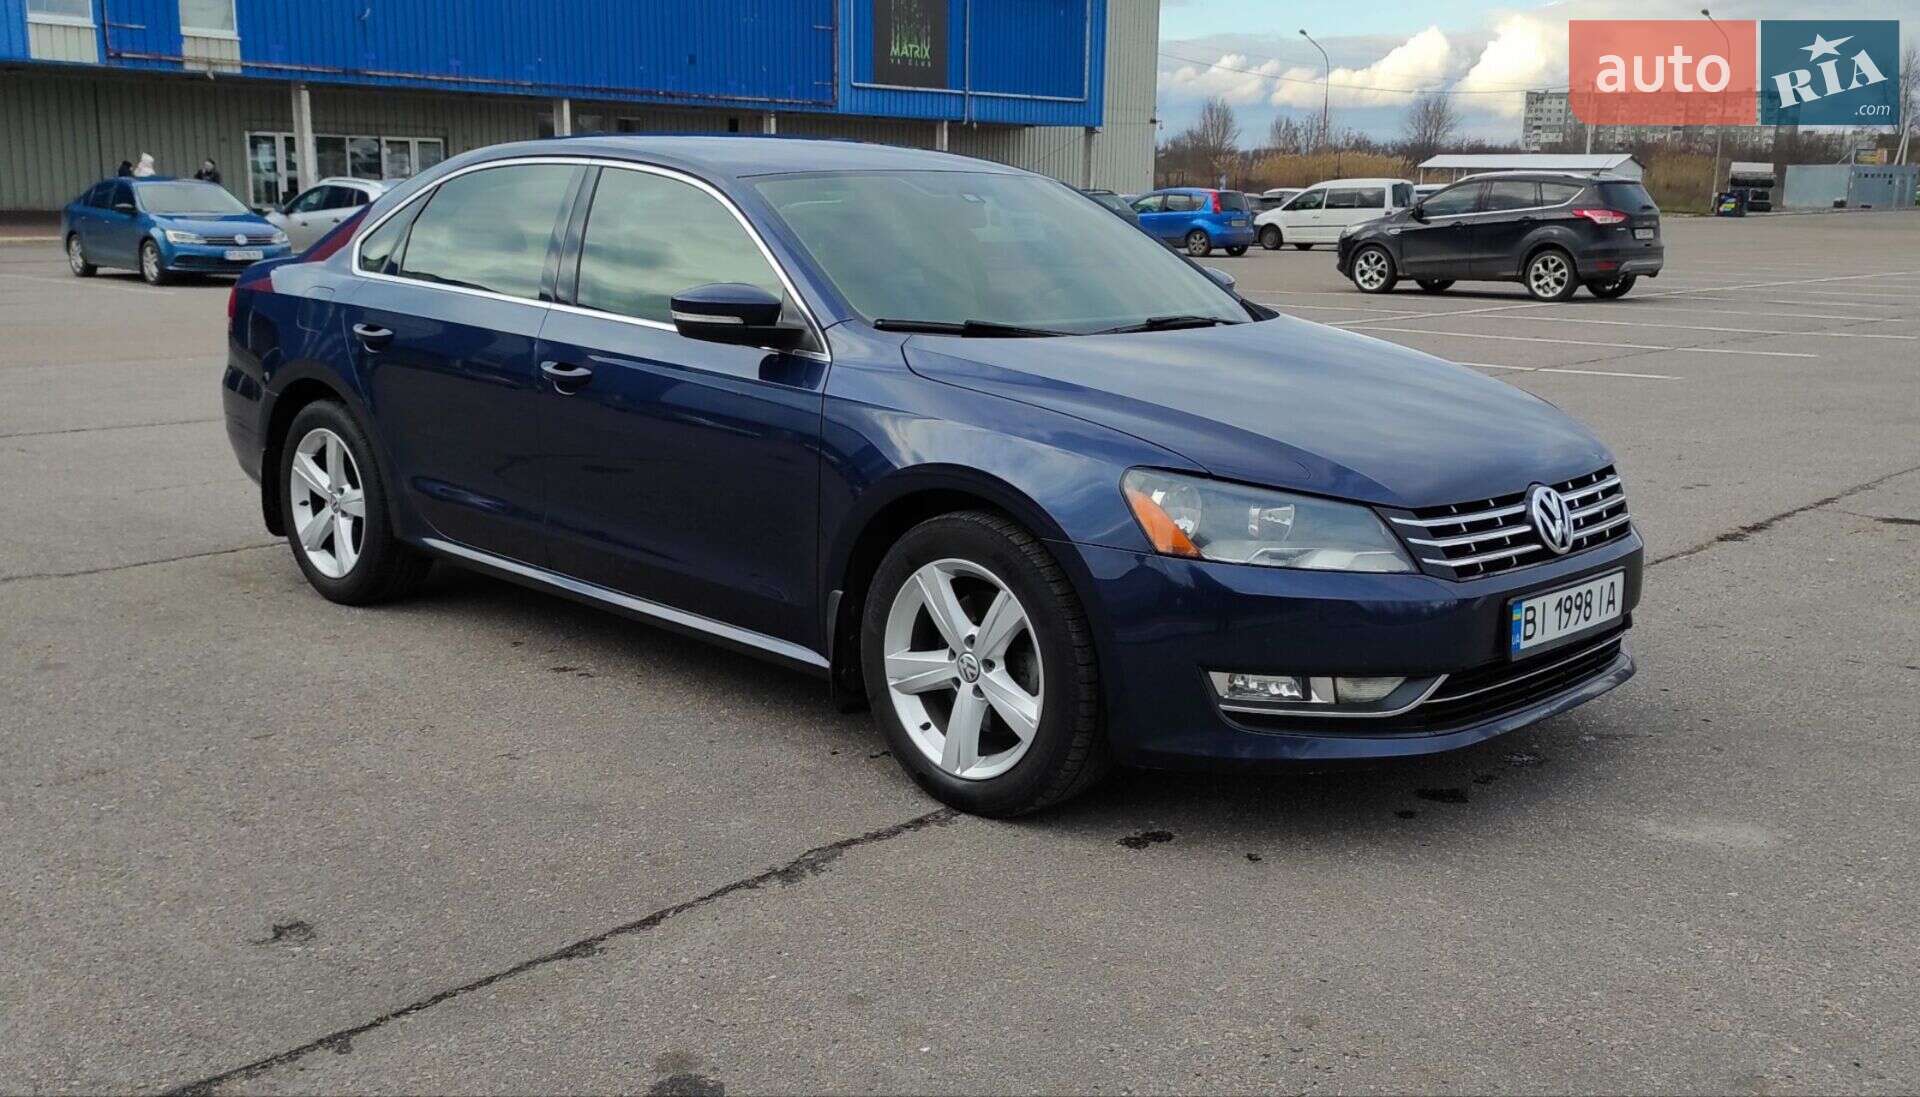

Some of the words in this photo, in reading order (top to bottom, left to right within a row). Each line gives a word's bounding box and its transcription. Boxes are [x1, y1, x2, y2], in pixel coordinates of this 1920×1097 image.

[889, 43, 931, 59] MATRIX
[1523, 601, 1546, 641] BI
[1554, 589, 1593, 631] 1998
[1599, 581, 1616, 617] IA
